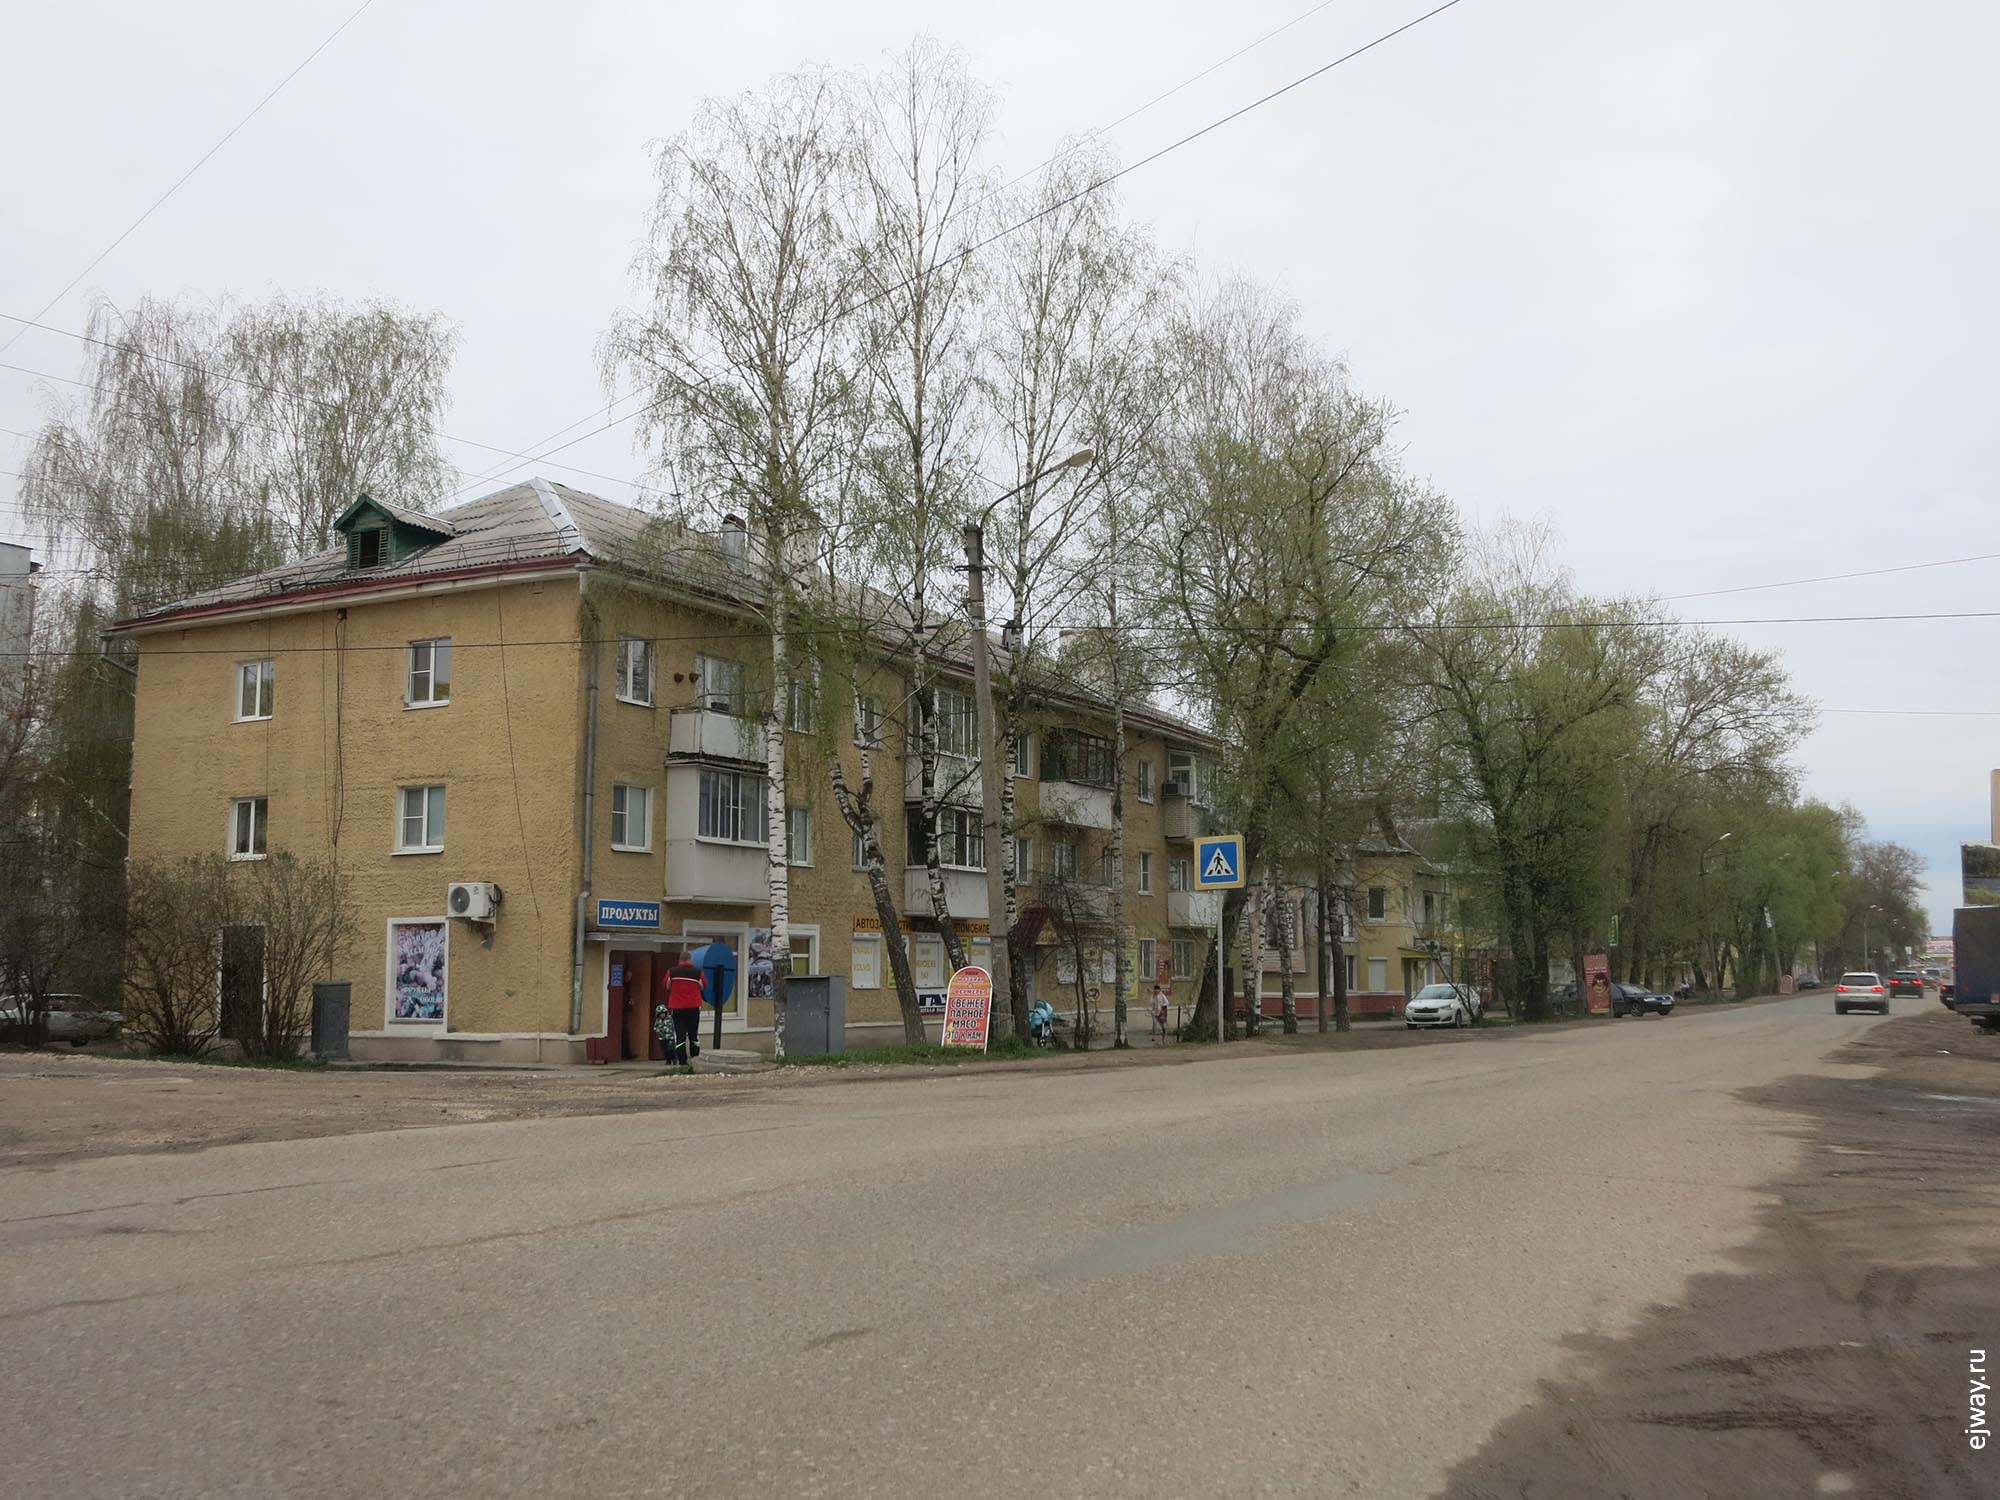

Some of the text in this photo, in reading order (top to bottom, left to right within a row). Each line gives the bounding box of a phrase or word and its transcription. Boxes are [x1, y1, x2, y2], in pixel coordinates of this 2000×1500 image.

[602, 907, 658, 921] ПРОДУКТЫ
[951, 998, 985, 1008] СВЕЖЕЕ
[950, 1009, 984, 1018] ПАРНОЕ
[946, 1030, 959, 1039] ЭТО
